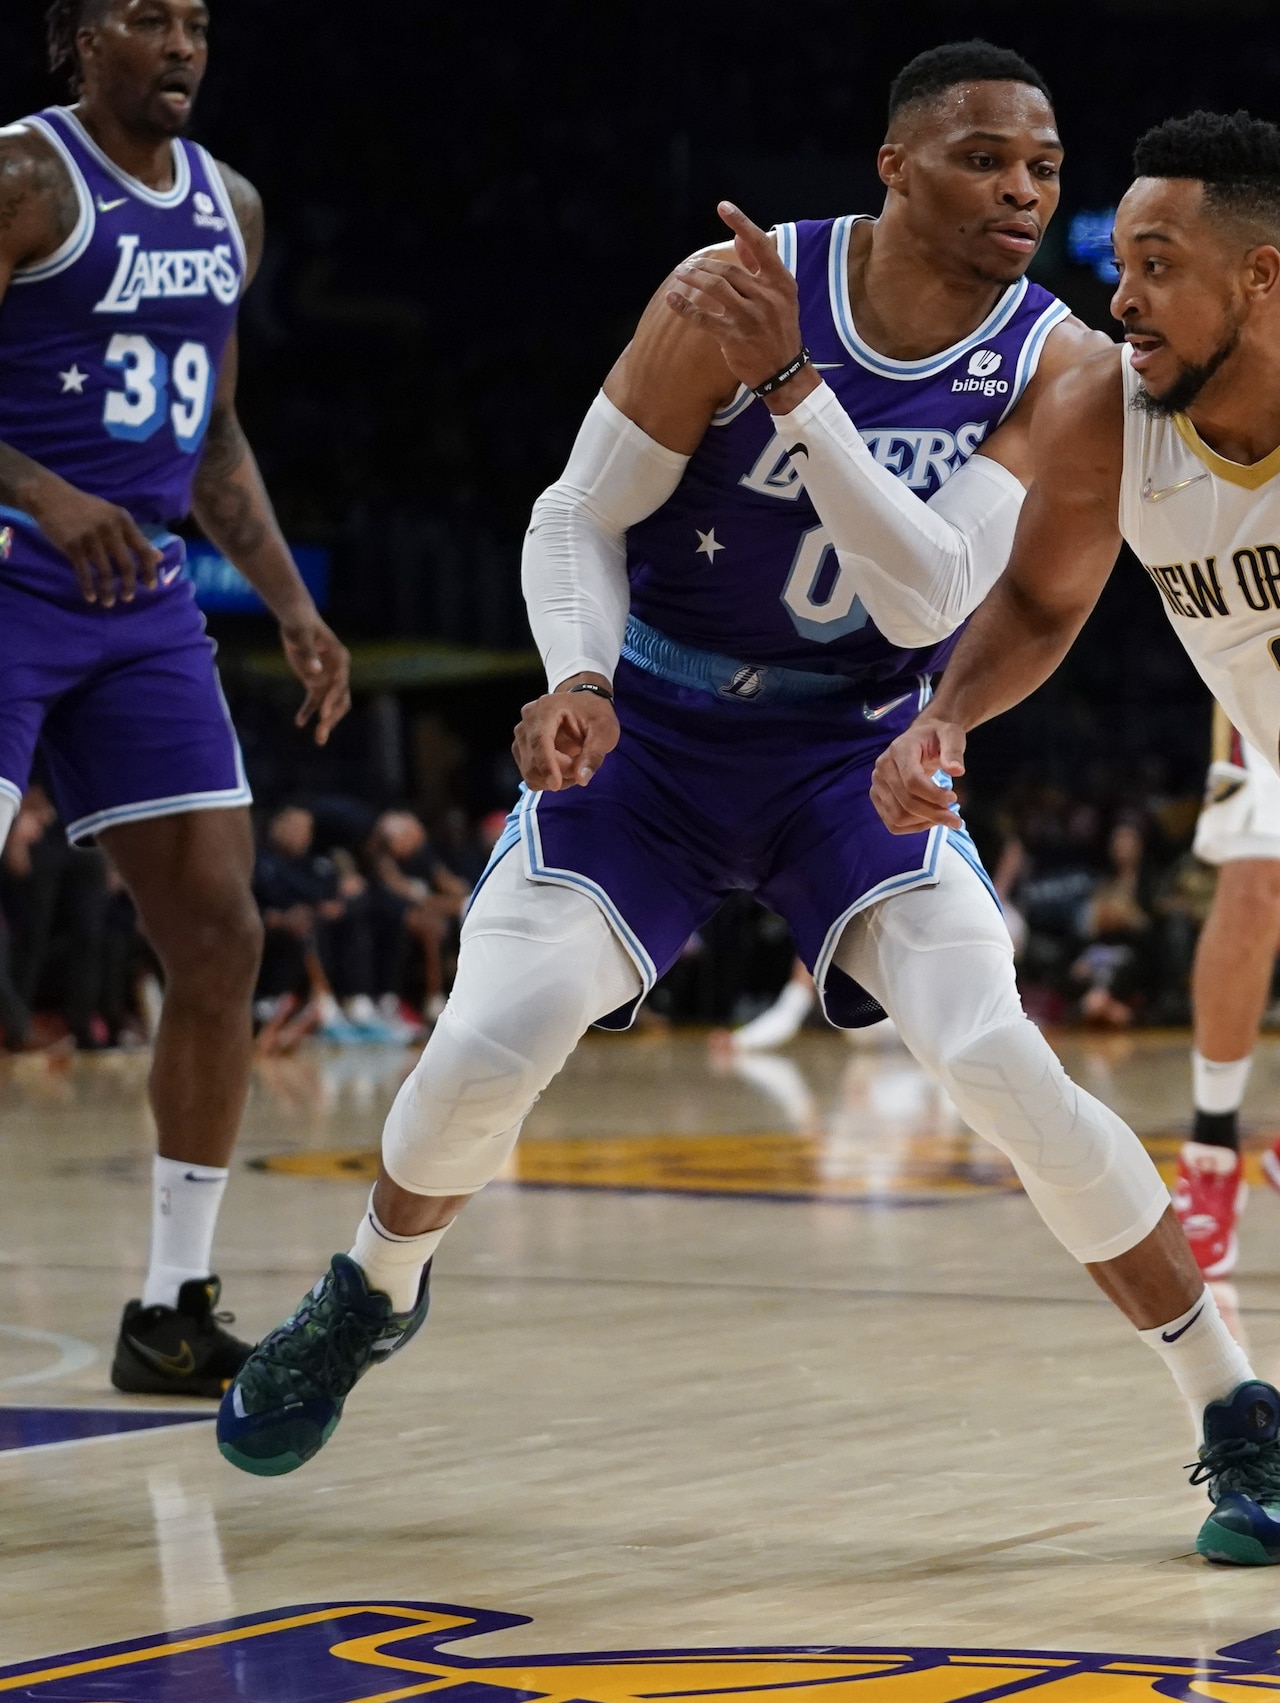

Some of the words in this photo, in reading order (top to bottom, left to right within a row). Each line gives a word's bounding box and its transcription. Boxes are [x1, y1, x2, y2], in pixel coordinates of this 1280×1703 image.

[93, 234, 240, 312] LAKERS
[103, 333, 215, 453] 39
[951, 378, 1009, 397] bibigo
[779, 523, 869, 644] 0
[1145, 555, 1231, 619] NEW
